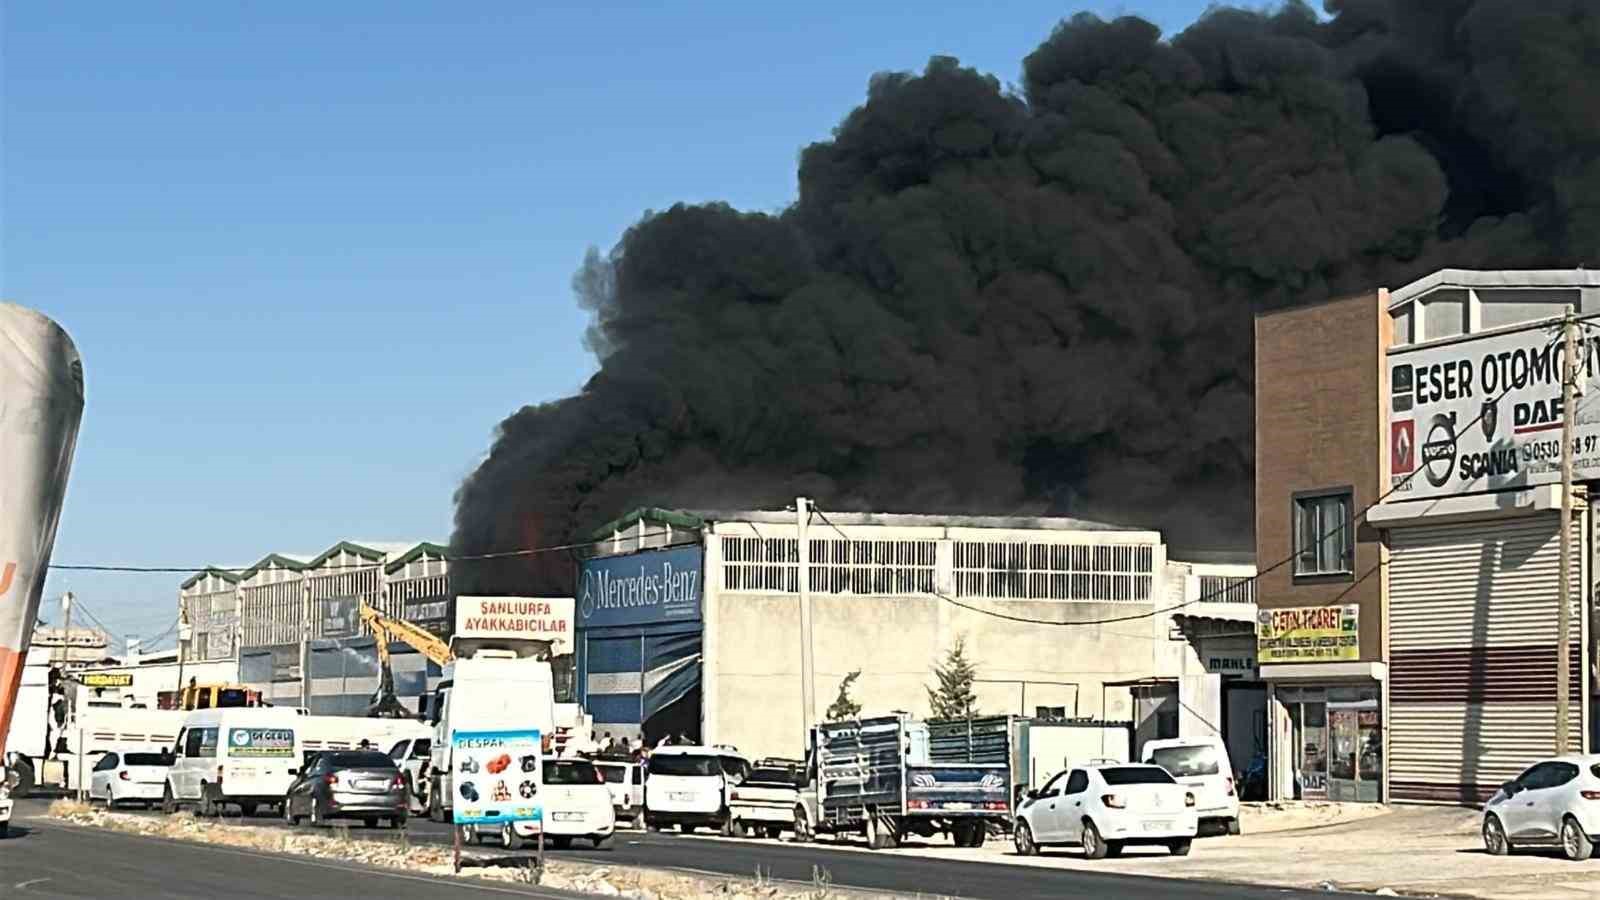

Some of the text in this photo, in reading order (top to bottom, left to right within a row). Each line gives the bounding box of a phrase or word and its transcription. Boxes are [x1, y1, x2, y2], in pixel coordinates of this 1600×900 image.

[1415, 360, 1473, 404] ESER
[1514, 398, 1564, 426] DAF
[1460, 448, 1518, 480] SCANIA
[1533, 440, 1559, 459] 0530
[597, 562, 697, 609] Mercedes-Benz
[465, 619, 566, 632] AYAKKABICILAR
